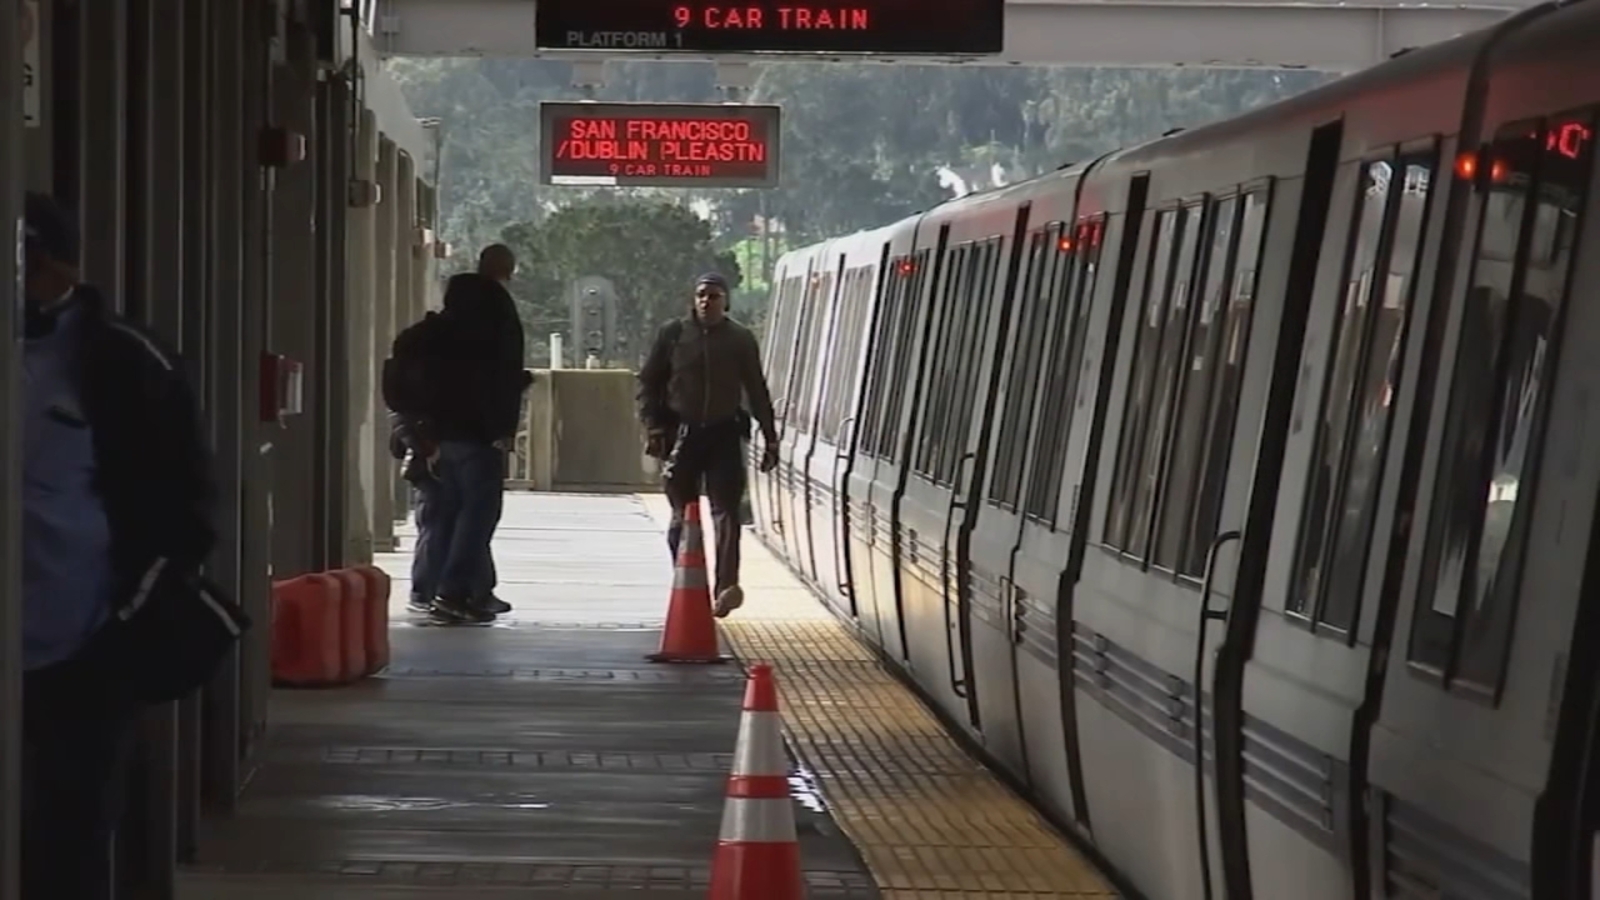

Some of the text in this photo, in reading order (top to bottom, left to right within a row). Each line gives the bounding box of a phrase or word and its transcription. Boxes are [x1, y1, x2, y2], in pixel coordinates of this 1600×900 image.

[674, 7, 868, 30] 9 CAR TRAIN
[566, 31, 683, 47] PLATFORM 1
[570, 120, 749, 141] SAN FRANCISCO
[556, 140, 764, 161] /DUBLIN PLEASTN
[609, 163, 711, 176] 9 CAR TRAIN
